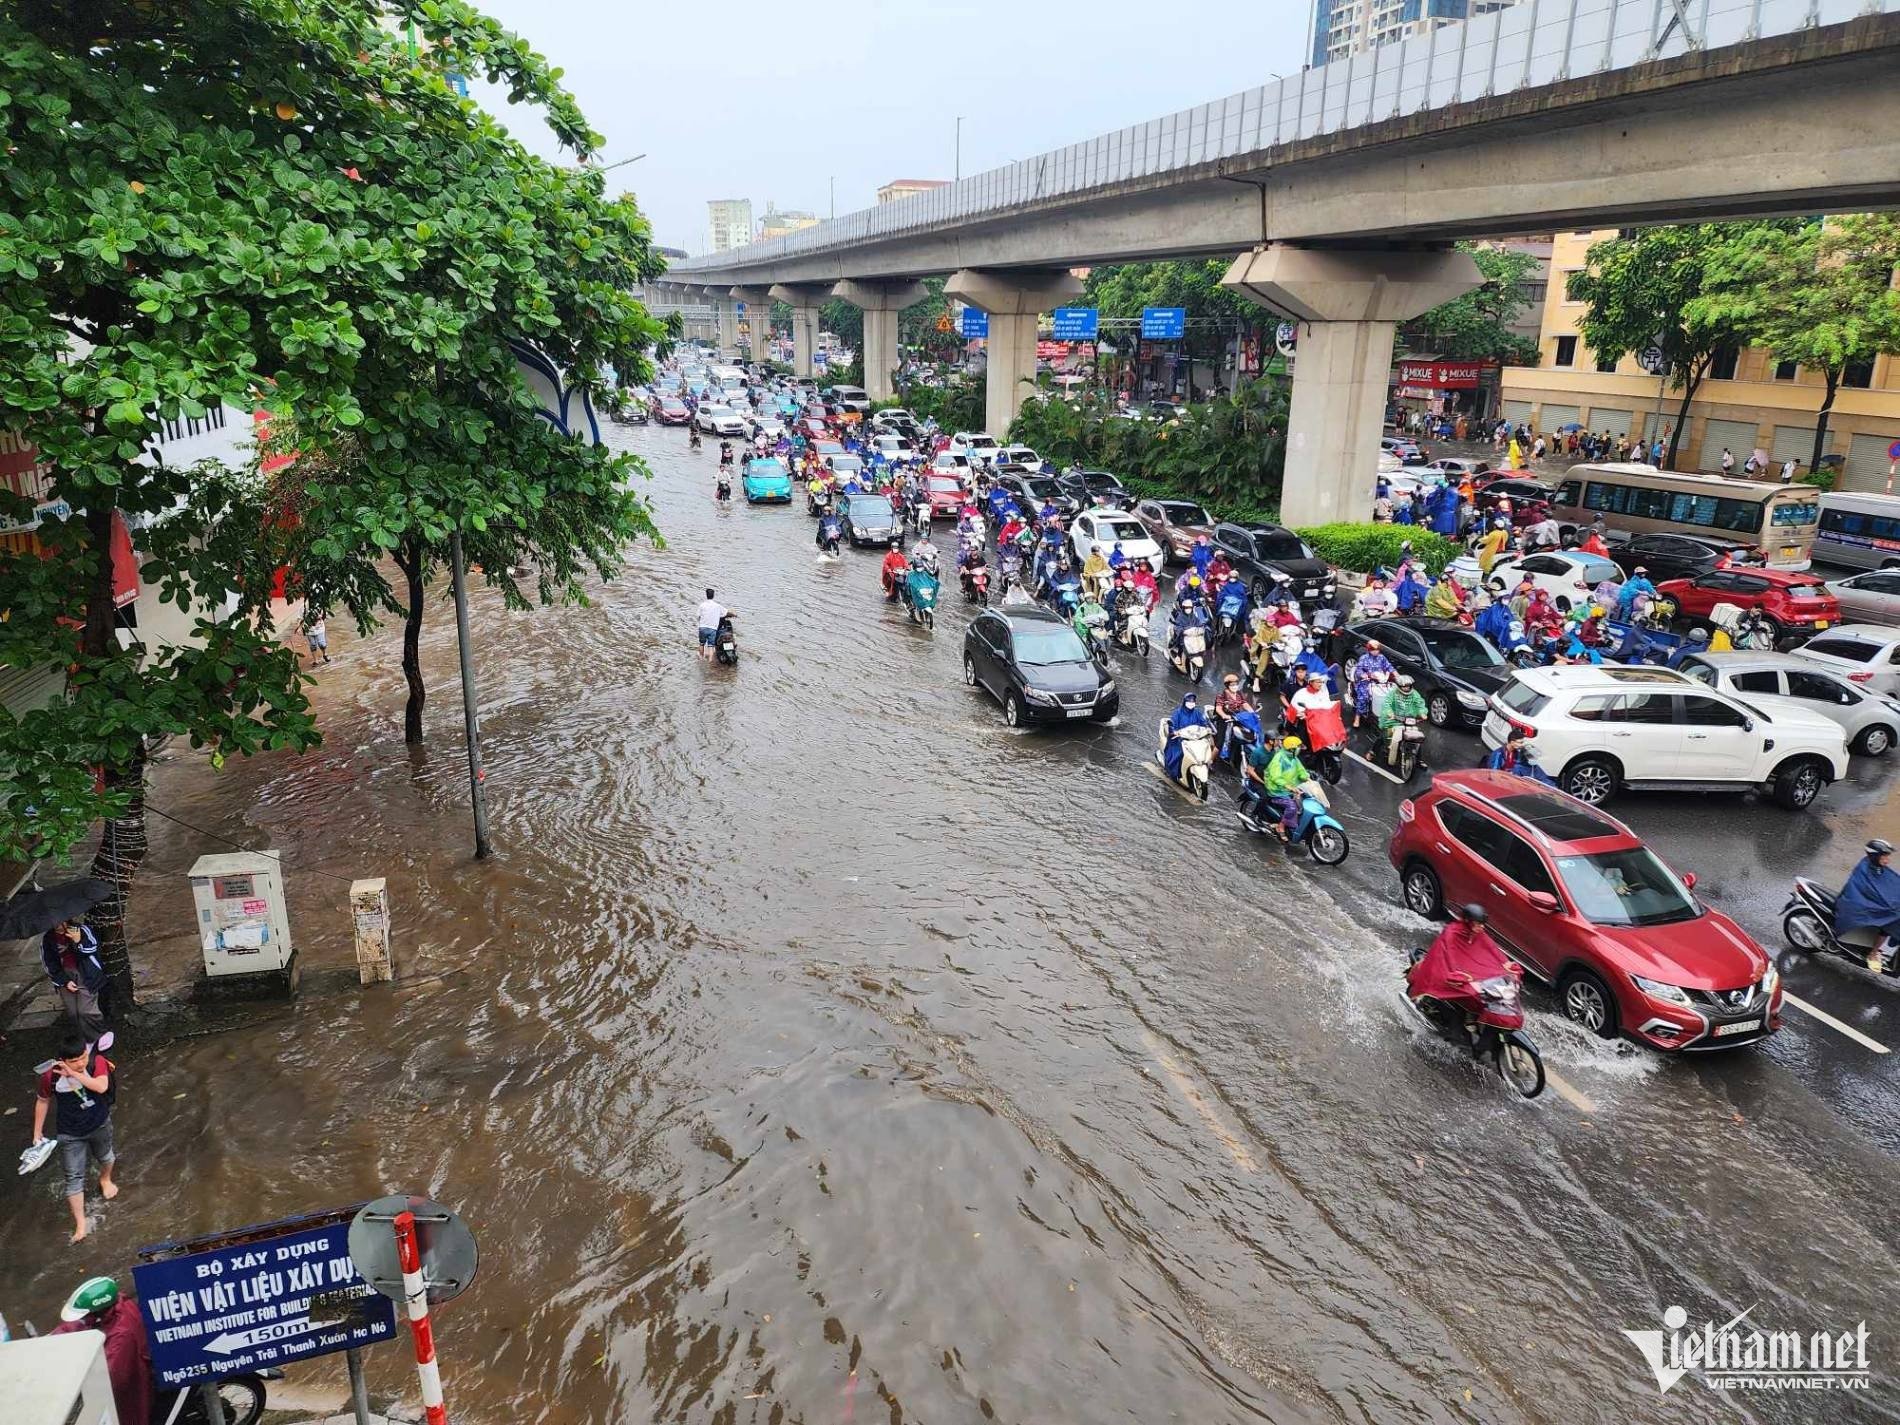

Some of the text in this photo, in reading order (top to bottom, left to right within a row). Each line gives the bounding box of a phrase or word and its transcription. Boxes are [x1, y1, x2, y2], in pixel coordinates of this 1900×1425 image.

[1409, 367, 1433, 378] MIXUE
[1449, 368, 1479, 378] MIXUE
[196, 1238, 330, 1278] BỘ XÂY DỰNG
[148, 1290, 197, 1322] VIỆN
[199, 1280, 236, 1312] VẬT
[241, 1270, 284, 1303] LIỆU
[287, 1262, 324, 1292] XÂY
[155, 1322, 203, 1344] VIETNAM
[204, 1310, 256, 1333] INSTITUTE
[257, 1306, 278, 1322] FOR
[242, 1322, 309, 1344] 150m
[282, 1338, 316, 1355] Thanh
